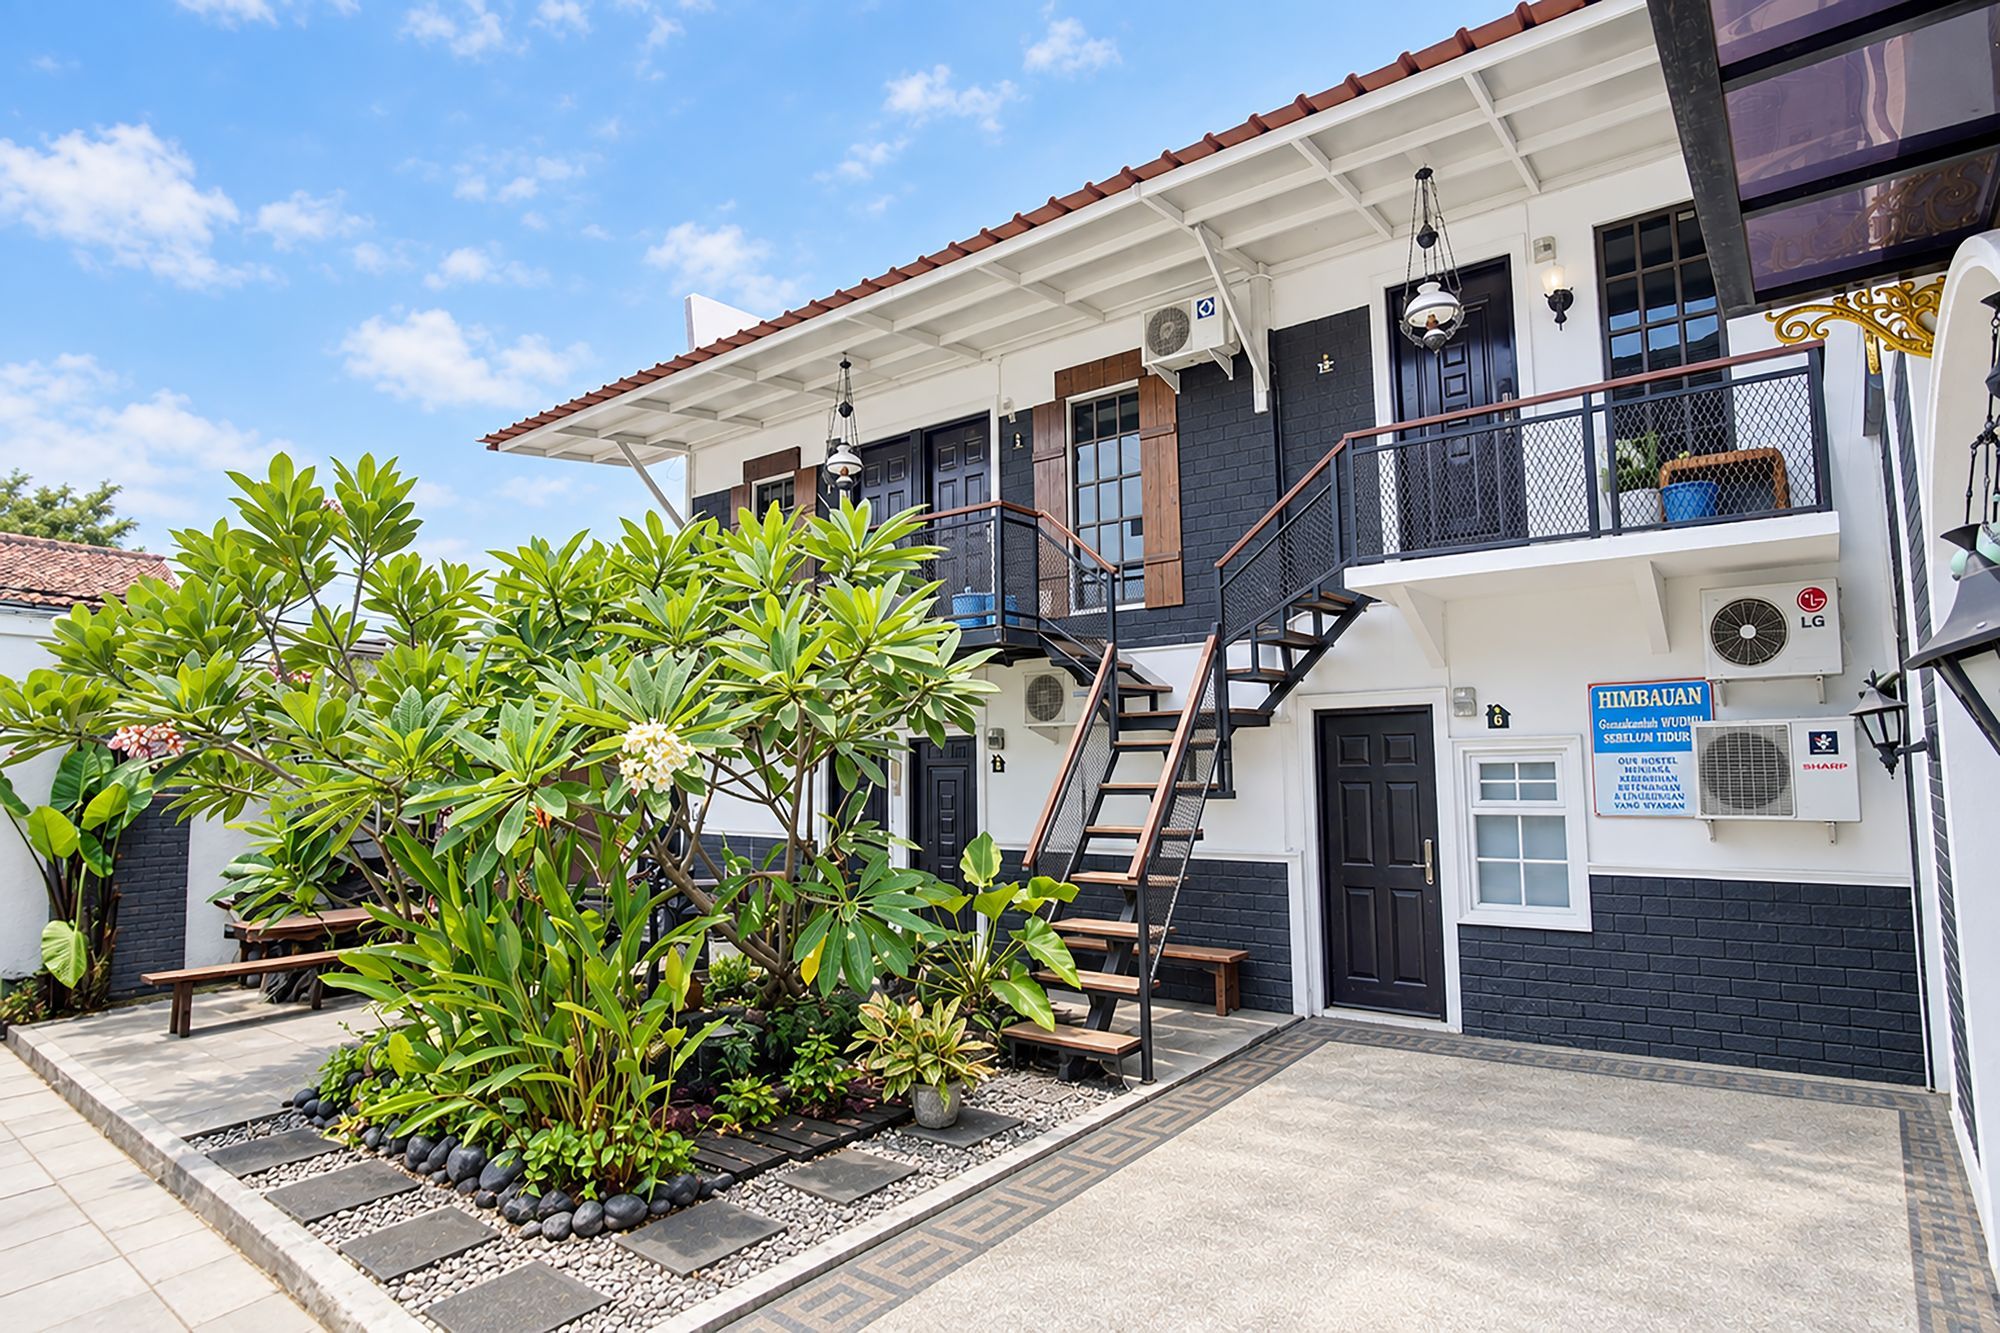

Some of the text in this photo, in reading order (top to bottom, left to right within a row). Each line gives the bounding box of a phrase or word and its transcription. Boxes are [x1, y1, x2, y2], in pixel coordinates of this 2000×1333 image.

[1801, 615, 1825, 628] LG
[1598, 687, 1702, 709] HIMBAUAN
[1493, 714, 1503, 726] 6
[1656, 731, 1690, 743] TIDUR
